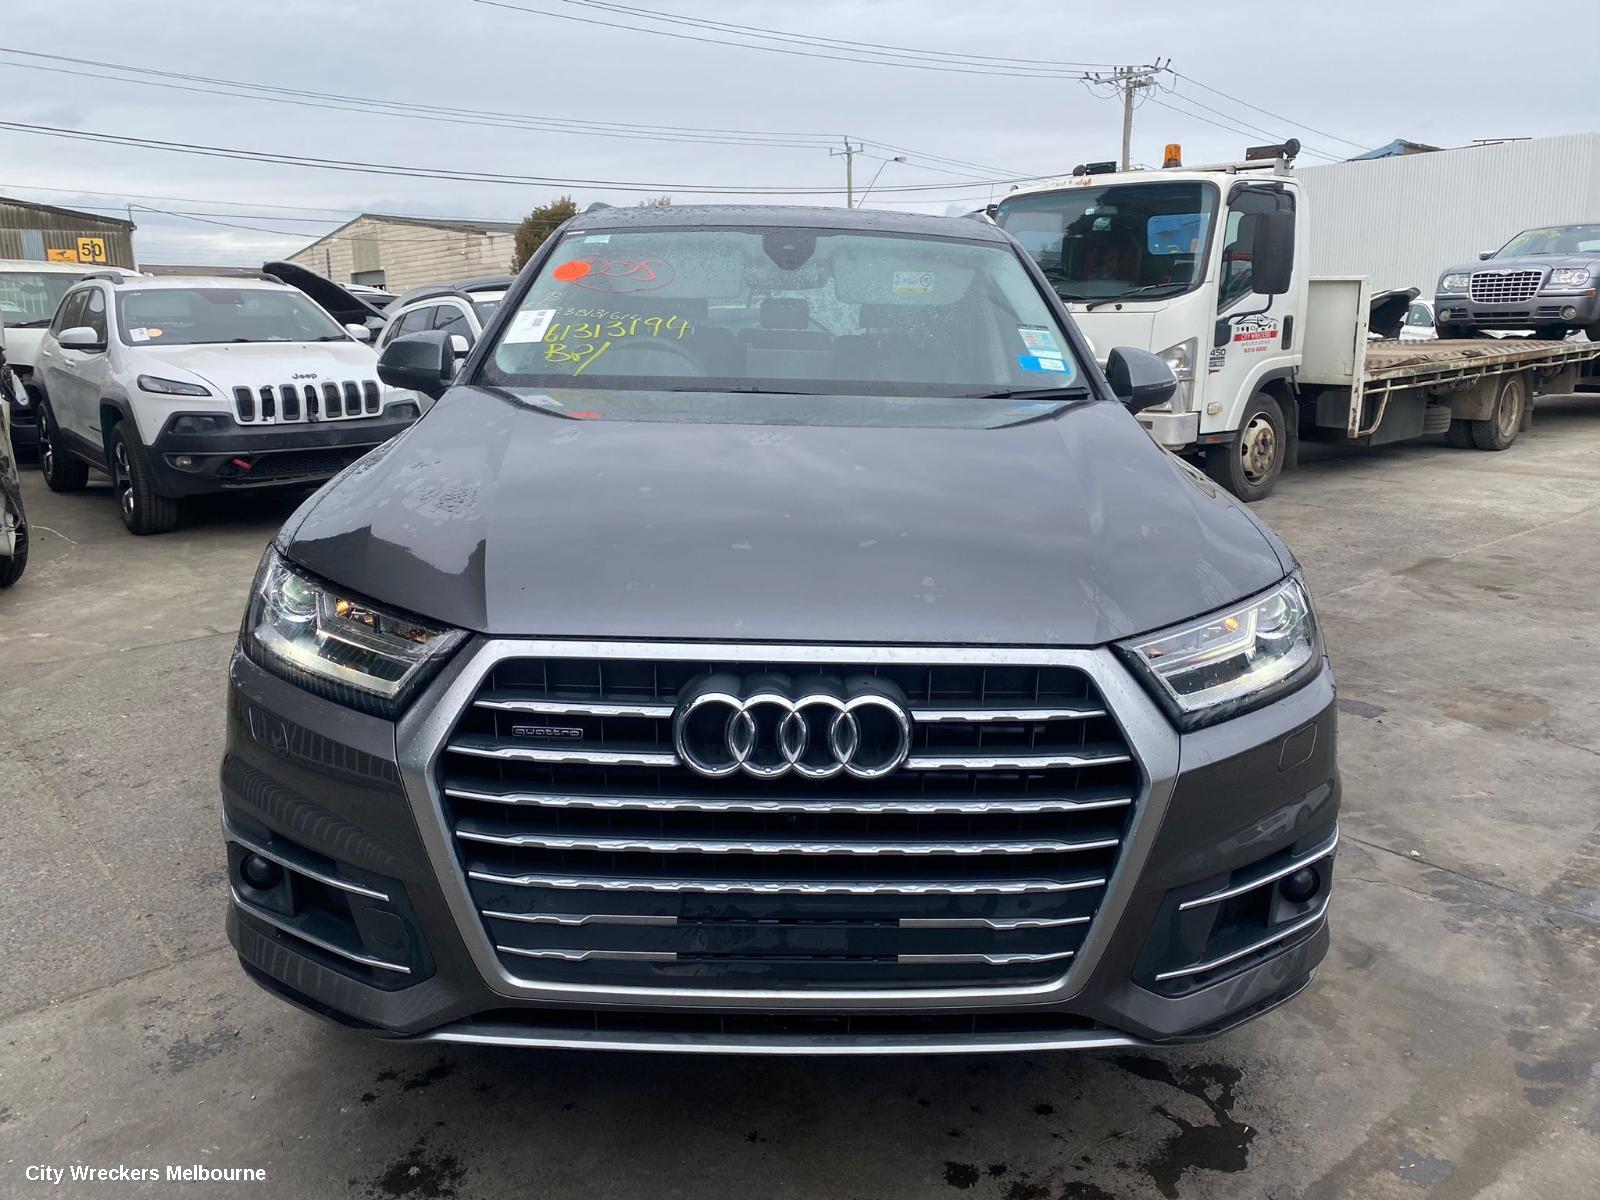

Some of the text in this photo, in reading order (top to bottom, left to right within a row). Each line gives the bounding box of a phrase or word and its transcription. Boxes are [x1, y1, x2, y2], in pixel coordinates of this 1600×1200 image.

[81, 242, 103, 257] 50
[1210, 348, 1227, 357] 450
[515, 728, 580, 737] quattro
